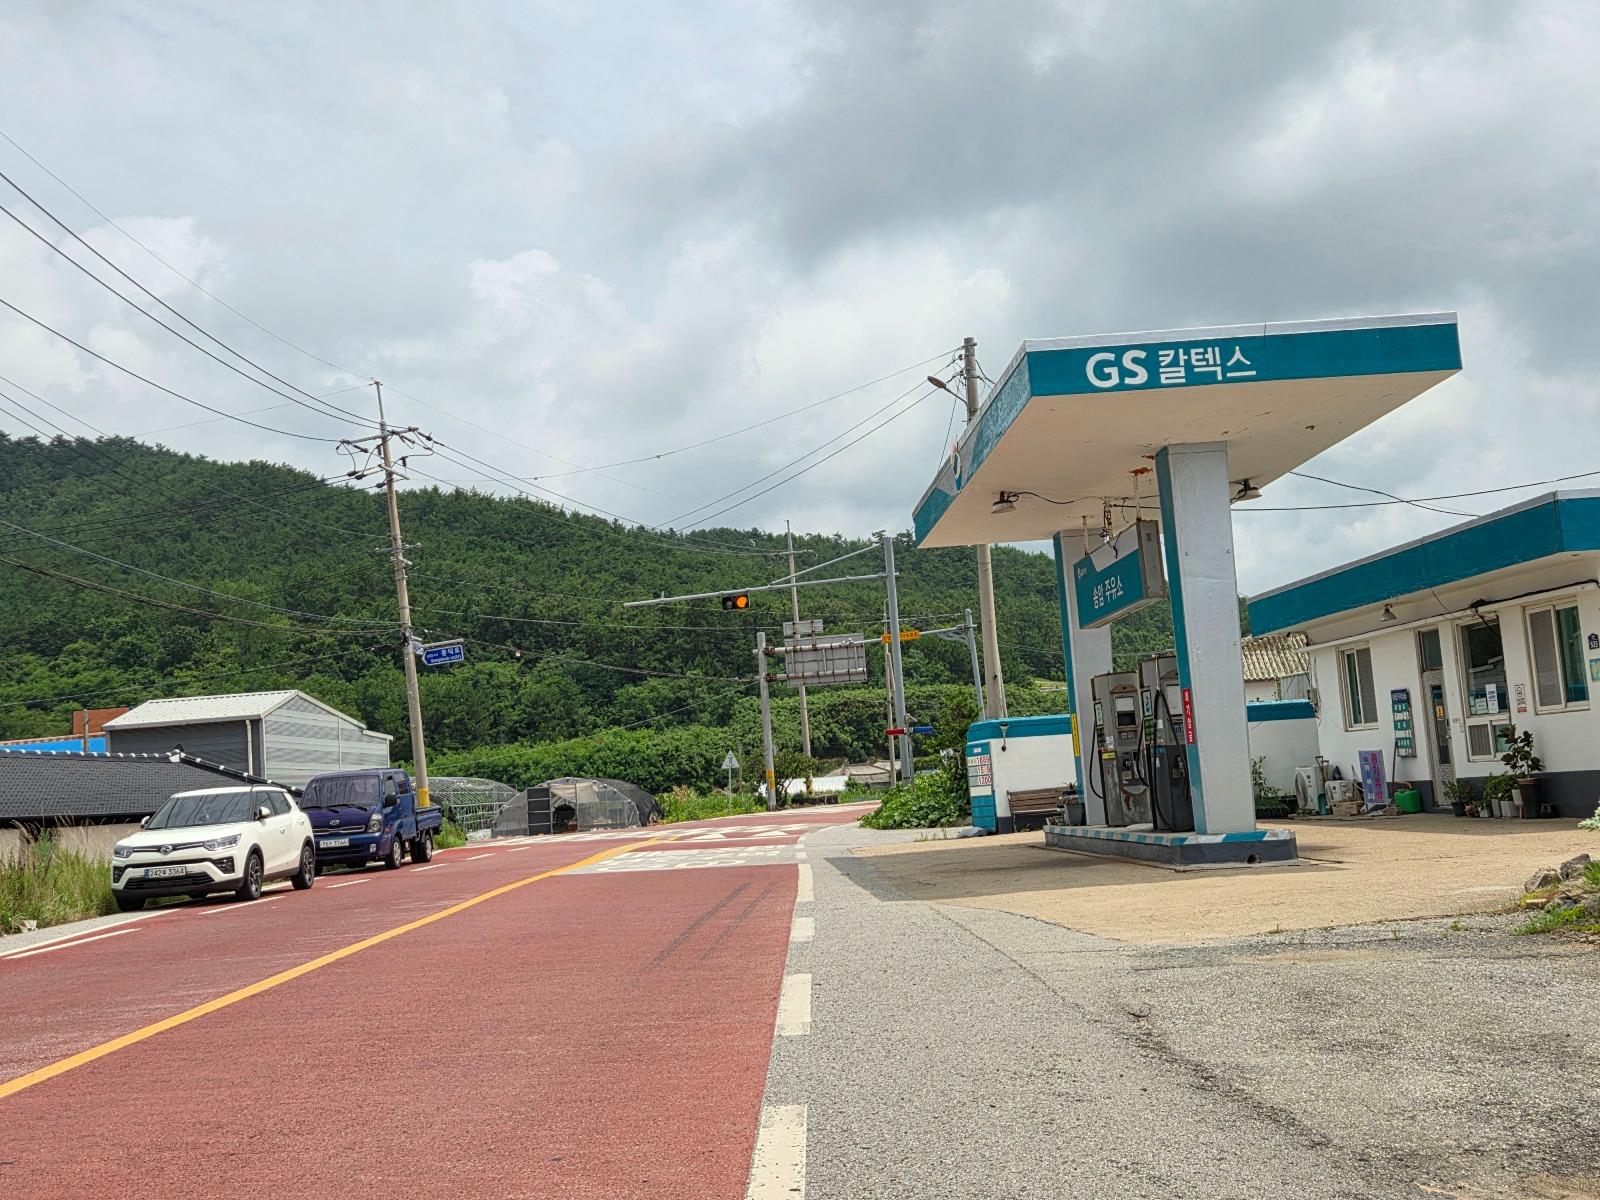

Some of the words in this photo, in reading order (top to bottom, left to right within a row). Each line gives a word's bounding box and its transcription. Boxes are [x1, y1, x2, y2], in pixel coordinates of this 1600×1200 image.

[1085, 349, 1149, 388] GS
[1158, 345, 1257, 384] 칼텍스
[1104, 575, 1124, 602] 주유소
